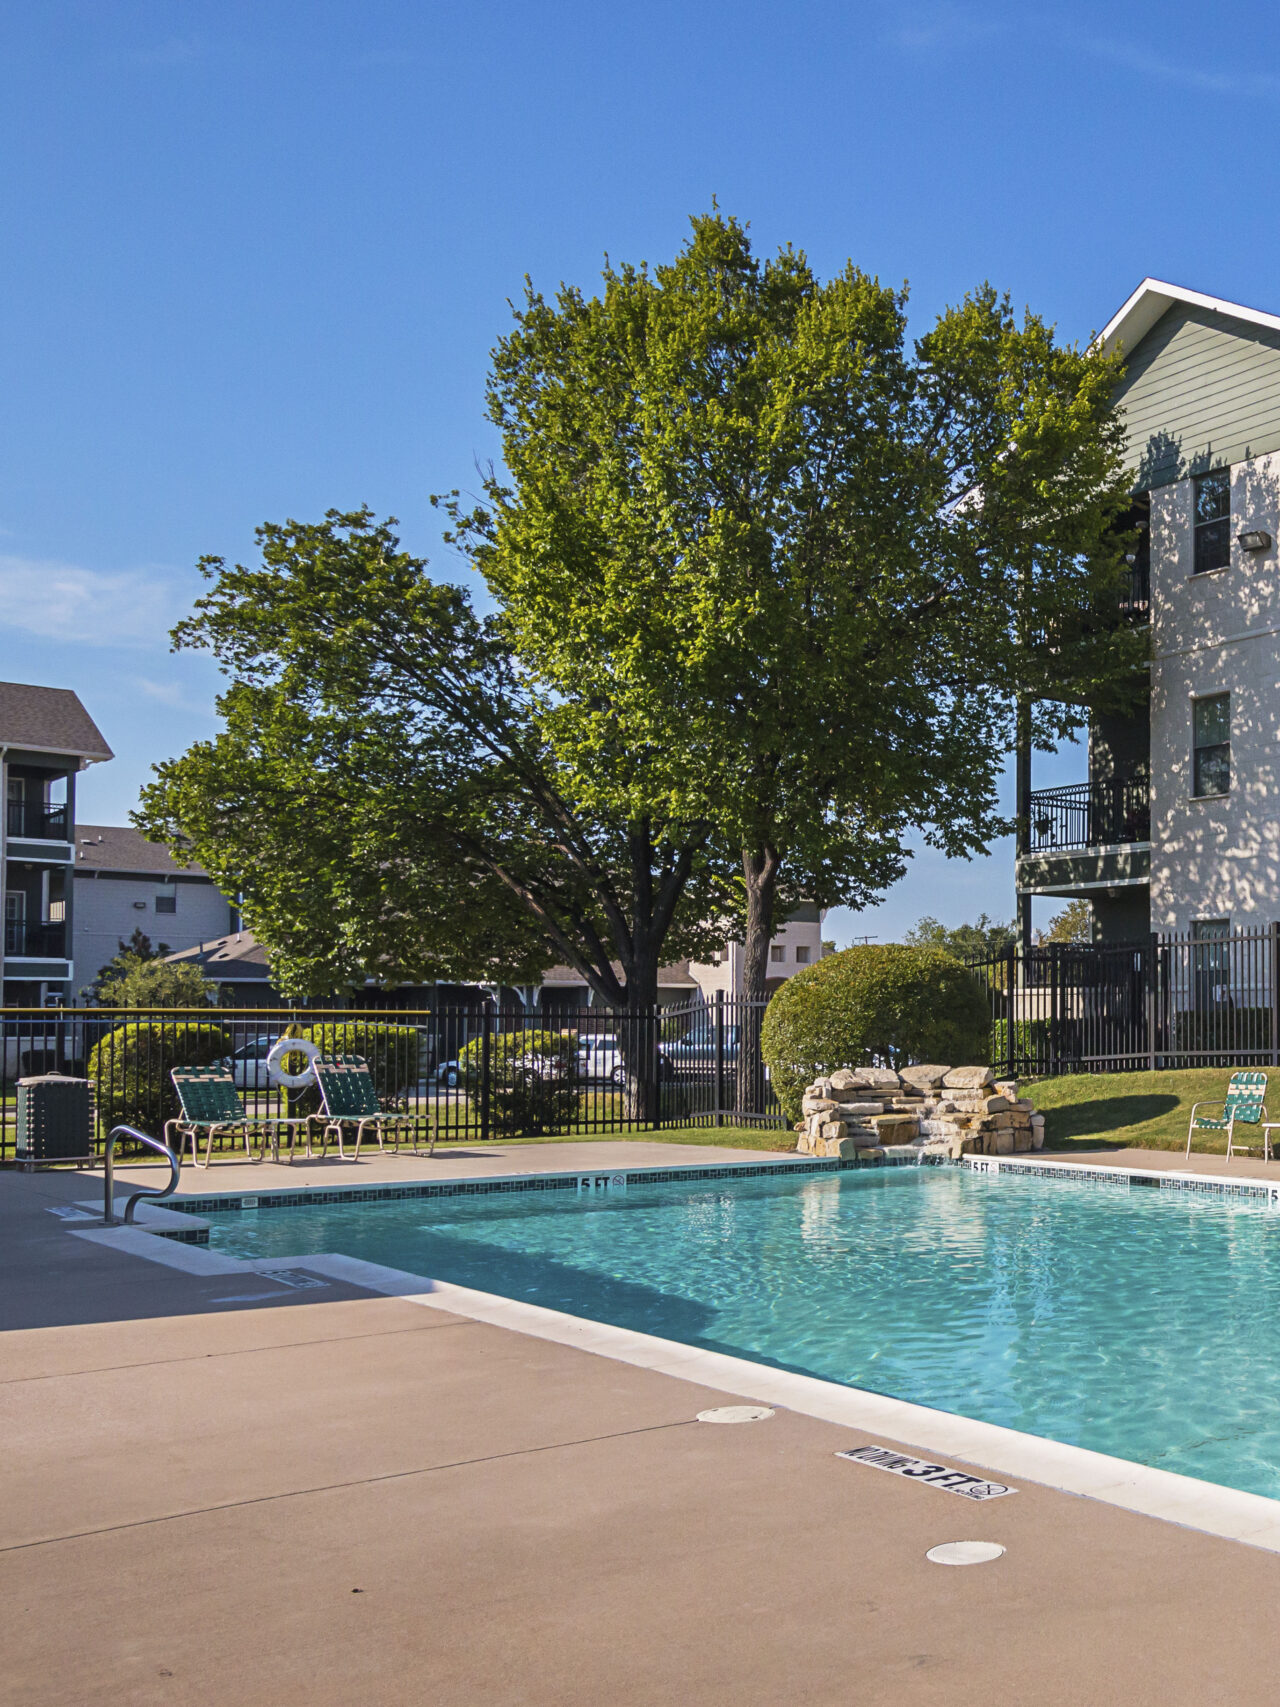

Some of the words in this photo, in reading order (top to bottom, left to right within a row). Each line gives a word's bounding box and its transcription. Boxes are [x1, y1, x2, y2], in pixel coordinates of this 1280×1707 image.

[973, 1162, 979, 1171] 5
[981, 1163, 989, 1172] FT
[581, 1178, 590, 1187] 5
[595, 1177, 610, 1187] FT
[1271, 1190, 1278, 1200] 5
[902, 1465, 946, 1477] 3
